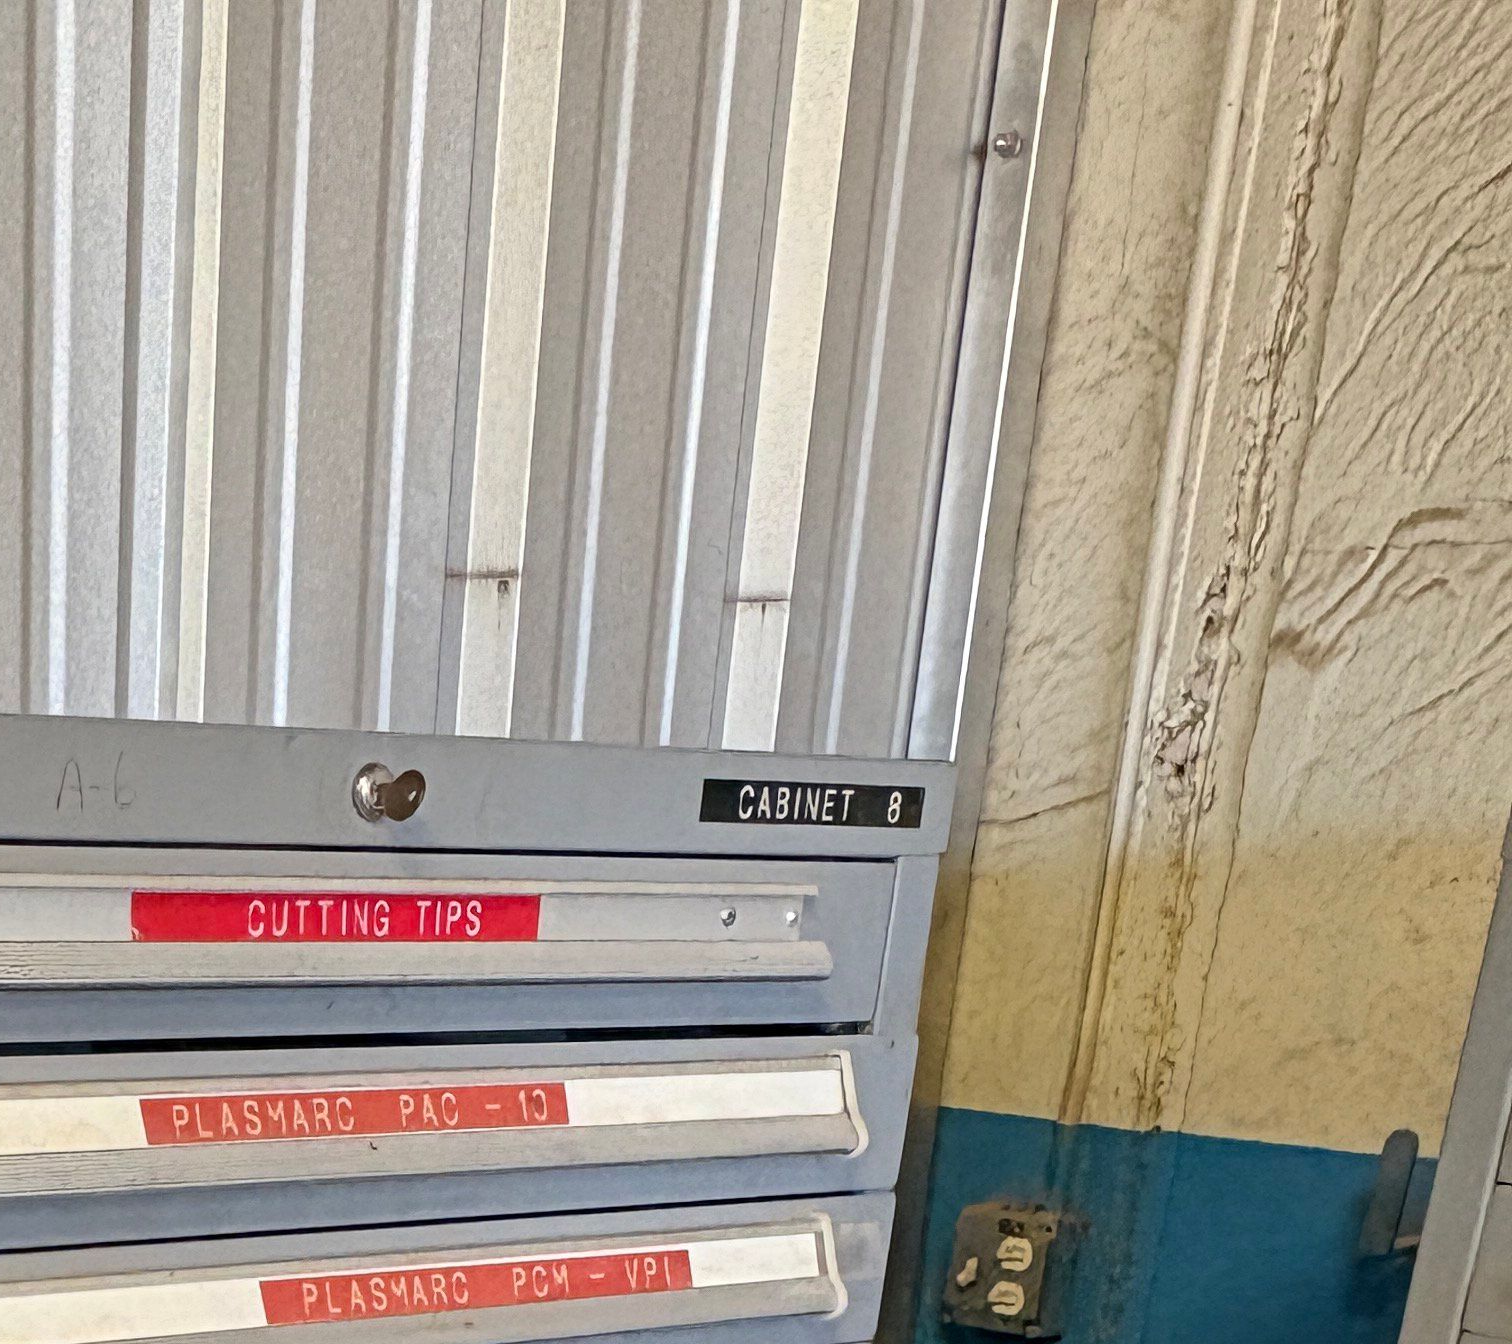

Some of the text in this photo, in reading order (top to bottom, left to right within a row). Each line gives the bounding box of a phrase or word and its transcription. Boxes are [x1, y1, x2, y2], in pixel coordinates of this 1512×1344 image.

[738, 784, 903, 824] CABINET 8
[247, 899, 482, 938] CUTTING TIPS
[171, 1096, 355, 1140] PLASMARC
[398, 1091, 459, 1128] PAC
[518, 1088, 547, 1122] 10
[302, 1271, 469, 1317] PLASMARC
[512, 1263, 570, 1297] PCM
